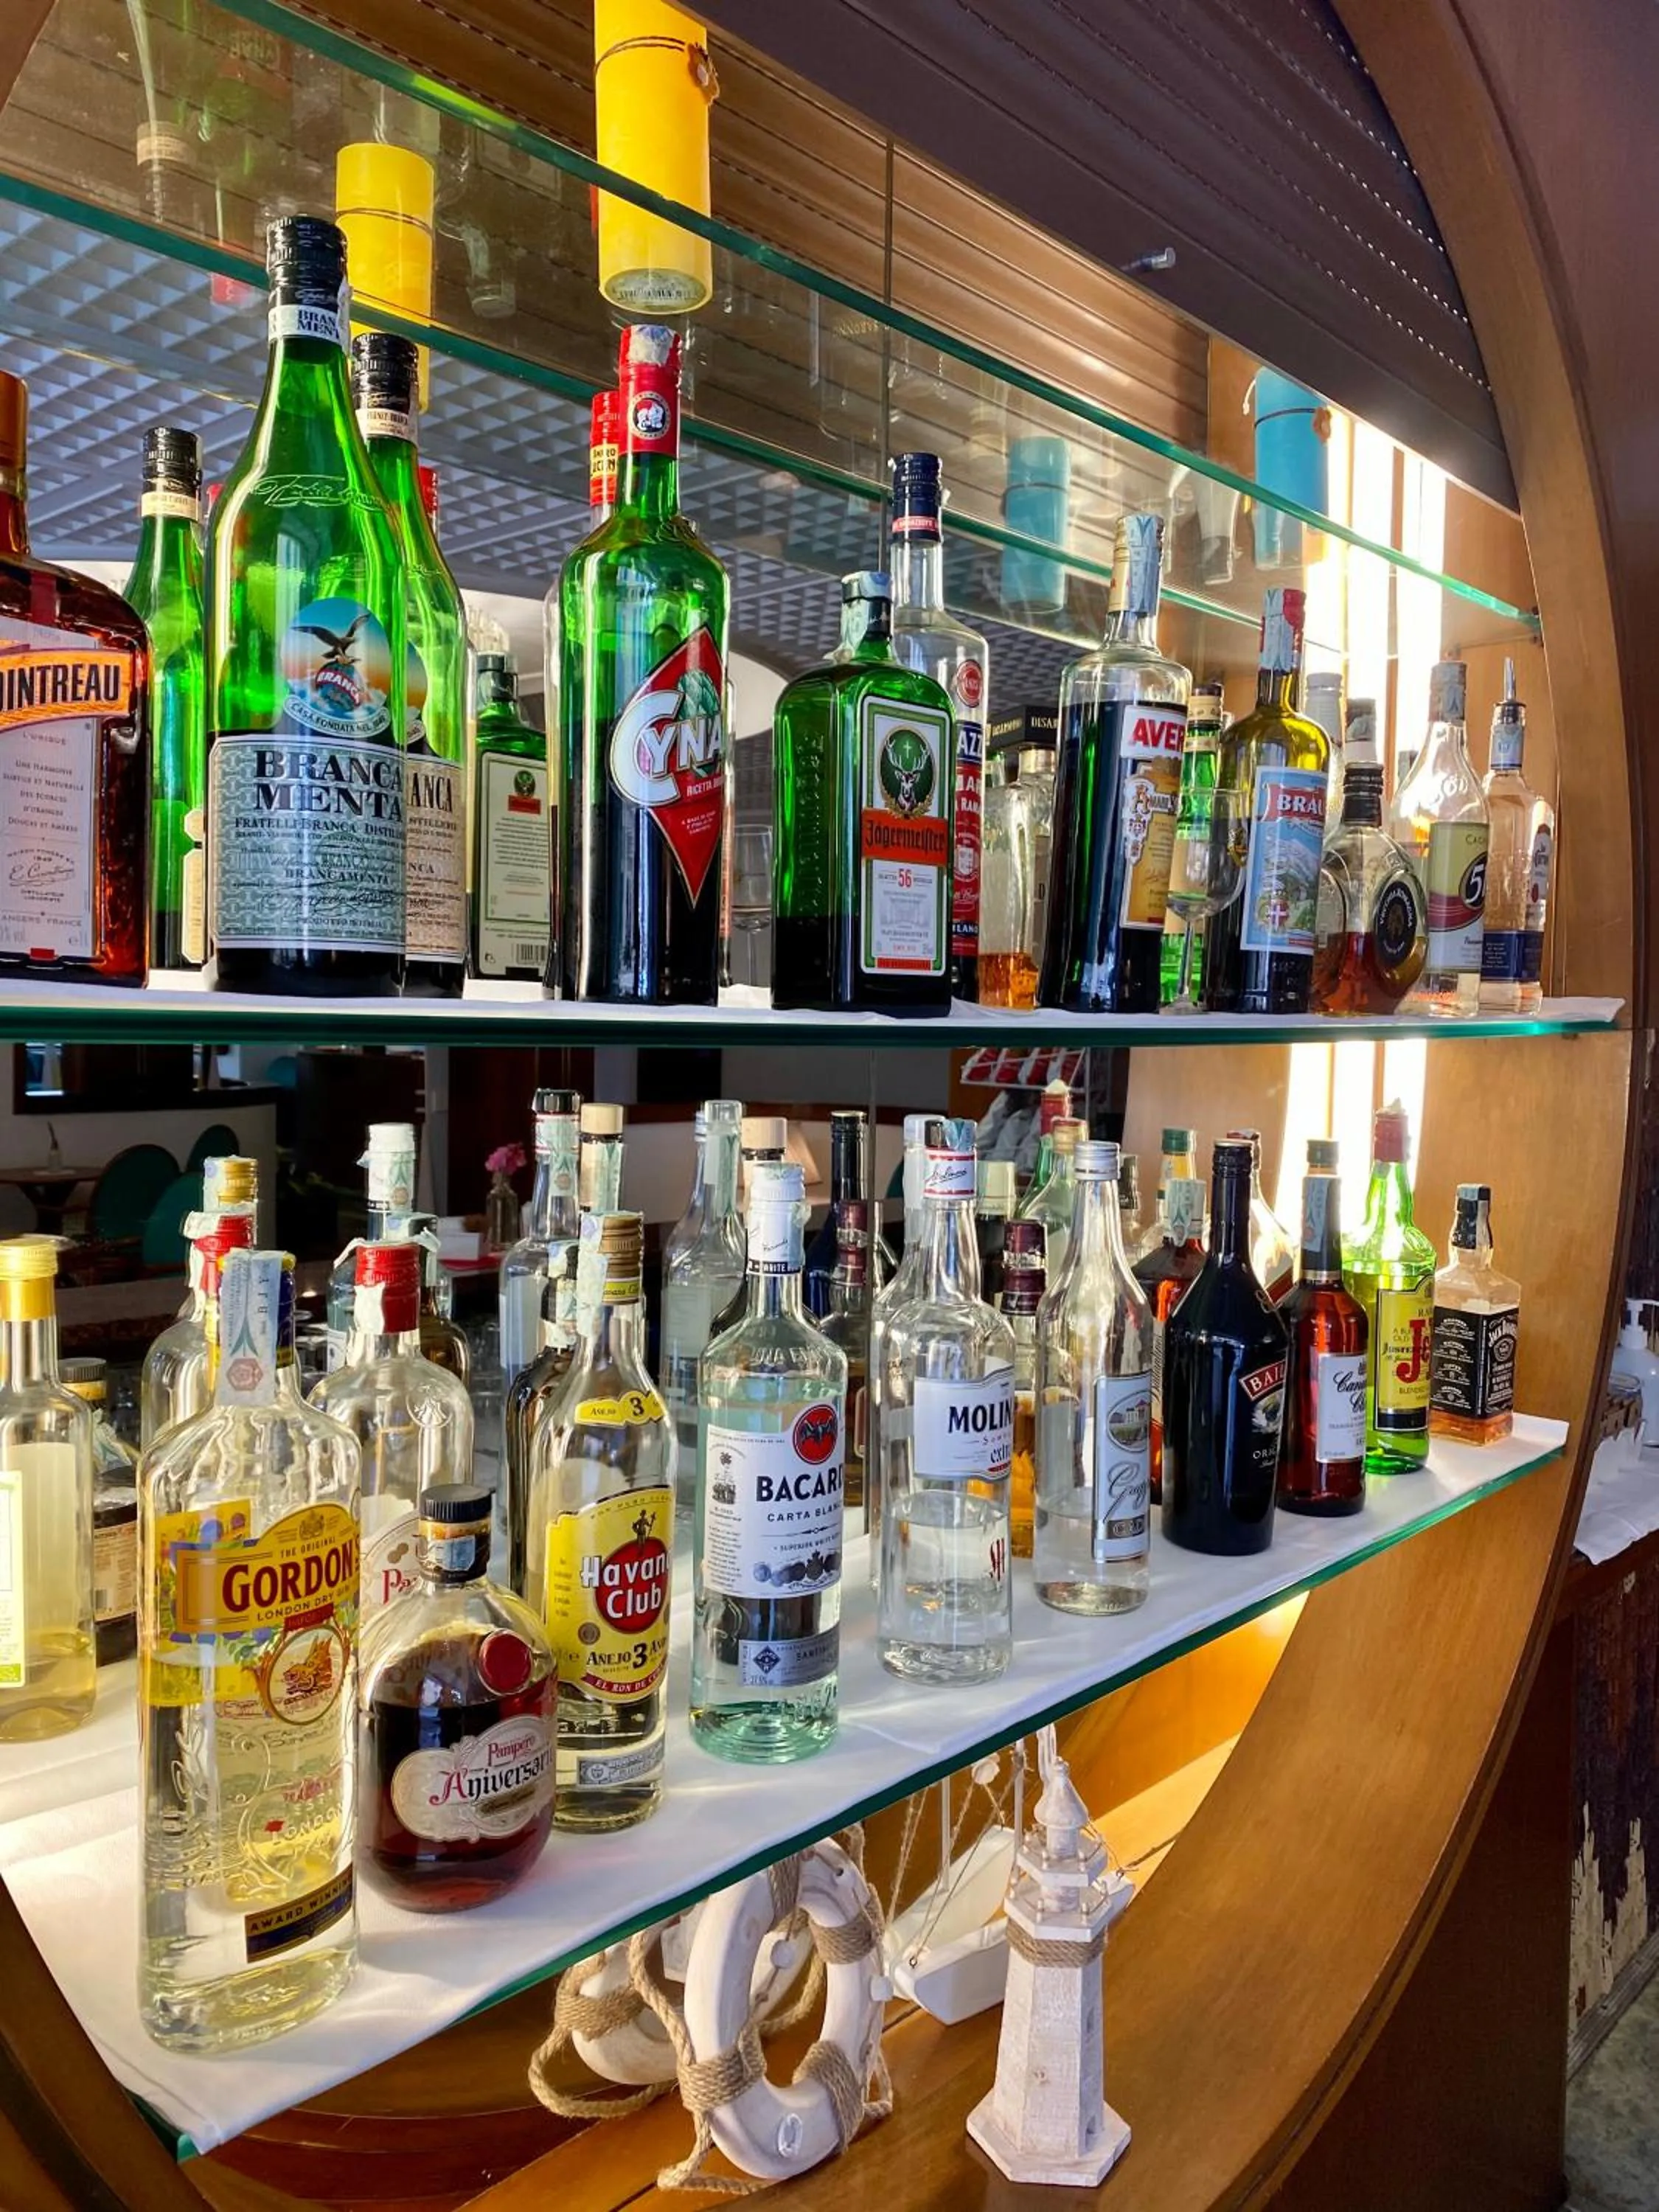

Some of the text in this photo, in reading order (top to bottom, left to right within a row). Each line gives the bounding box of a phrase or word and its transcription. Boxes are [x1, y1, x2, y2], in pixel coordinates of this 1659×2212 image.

[0, 663, 121, 711] INTREAU
[254, 749, 402, 793] BRANCA
[254, 782, 403, 823] MENTA
[897, 868, 913, 888] 56
[630, 1397, 645, 1416] 3
[767, 1510, 810, 1523] CARTA
[280, 1536, 336, 1559] THE ORIGINAL
[257, 1601, 310, 1622] LONDON
[314, 1593, 334, 1607] DRY
[605, 1582, 662, 1619] Club
[586, 1651, 631, 1666] AÑEJO
[632, 1642, 649, 1669] 3
[594, 1679, 608, 1690] EL
[612, 1682, 632, 1693] RON
[634, 1680, 647, 1691] DE
[487, 1733, 536, 1767] Pampero
[249, 1906, 304, 1933] AWARD
